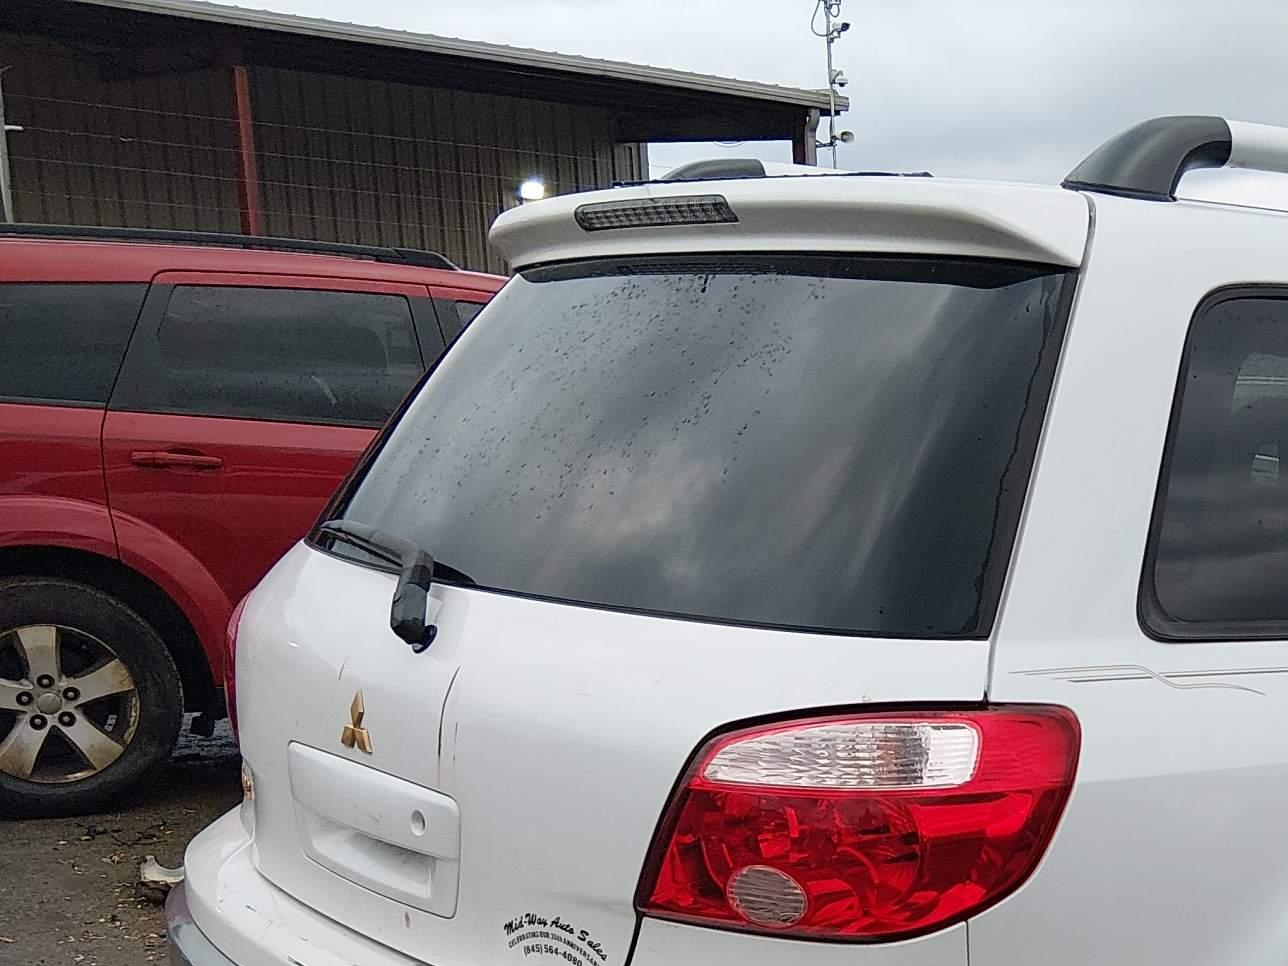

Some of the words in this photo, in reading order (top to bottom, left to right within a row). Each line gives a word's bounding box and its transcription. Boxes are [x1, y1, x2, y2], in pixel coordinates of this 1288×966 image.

[503, 913, 548, 936] Mid-Way
[549, 916, 575, 935] Auto
[577, 929, 608, 962] Sales
[523, 943, 543, 957] (845)
